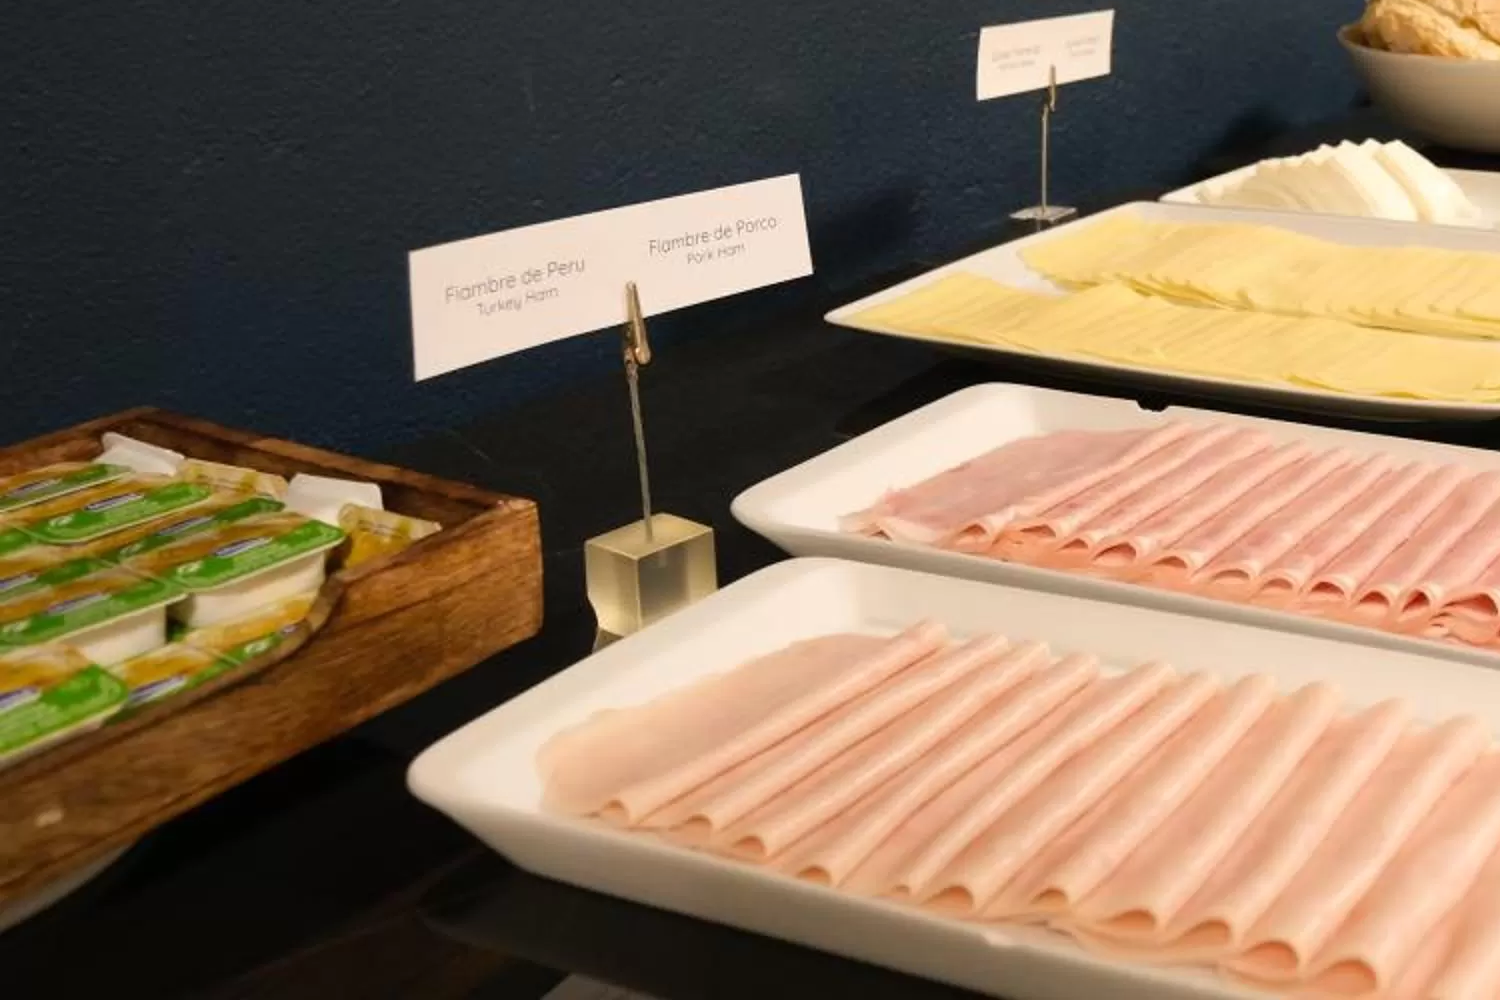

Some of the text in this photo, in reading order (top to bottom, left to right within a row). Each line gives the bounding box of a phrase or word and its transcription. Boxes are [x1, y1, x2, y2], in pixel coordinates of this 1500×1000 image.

[649, 216, 777, 256] Fiambre de Porco
[445, 258, 585, 304] Fiambre de Peru
[477, 287, 559, 317] Turkey Ham
